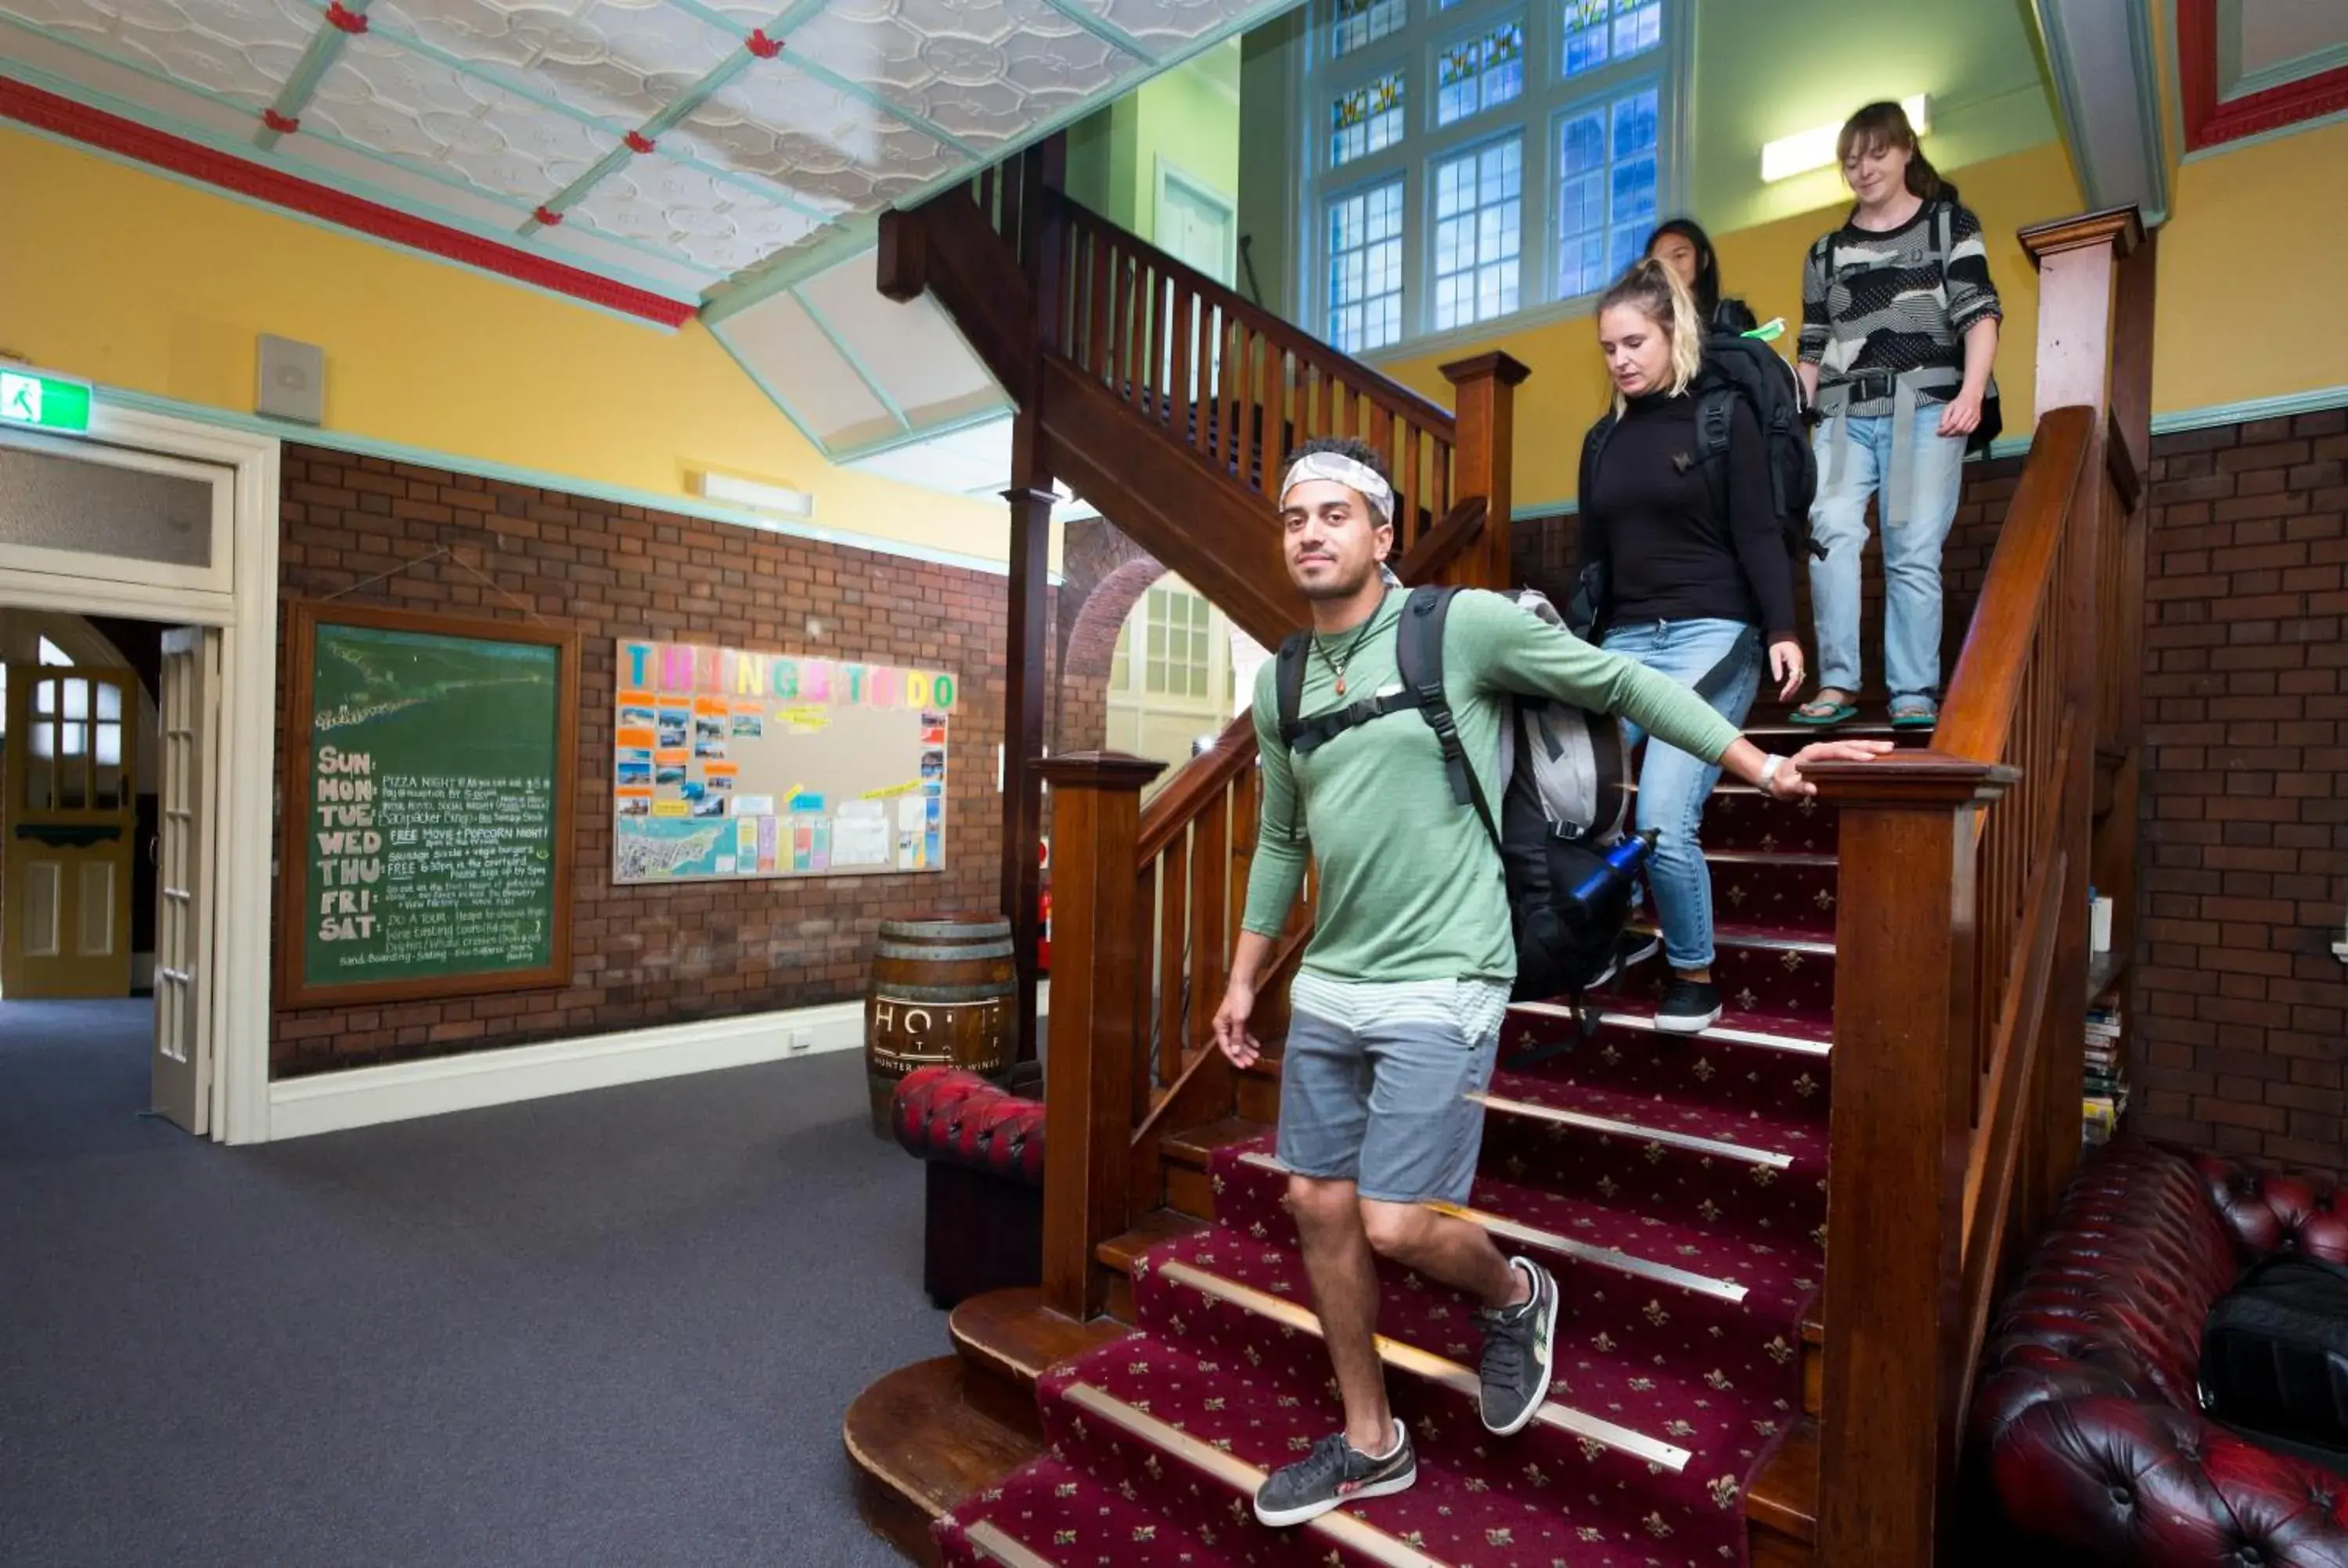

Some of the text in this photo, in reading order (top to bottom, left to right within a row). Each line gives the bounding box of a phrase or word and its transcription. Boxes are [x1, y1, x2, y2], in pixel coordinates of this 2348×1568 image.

[907, 669, 953, 710] DO
[383, 775, 417, 789] PIZZA
[391, 829, 418, 842] FREE
[423, 828, 454, 840] MOVIE
[464, 826, 513, 840] POPCORN
[388, 862, 416, 876] FREE
[409, 913, 418, 924] A
